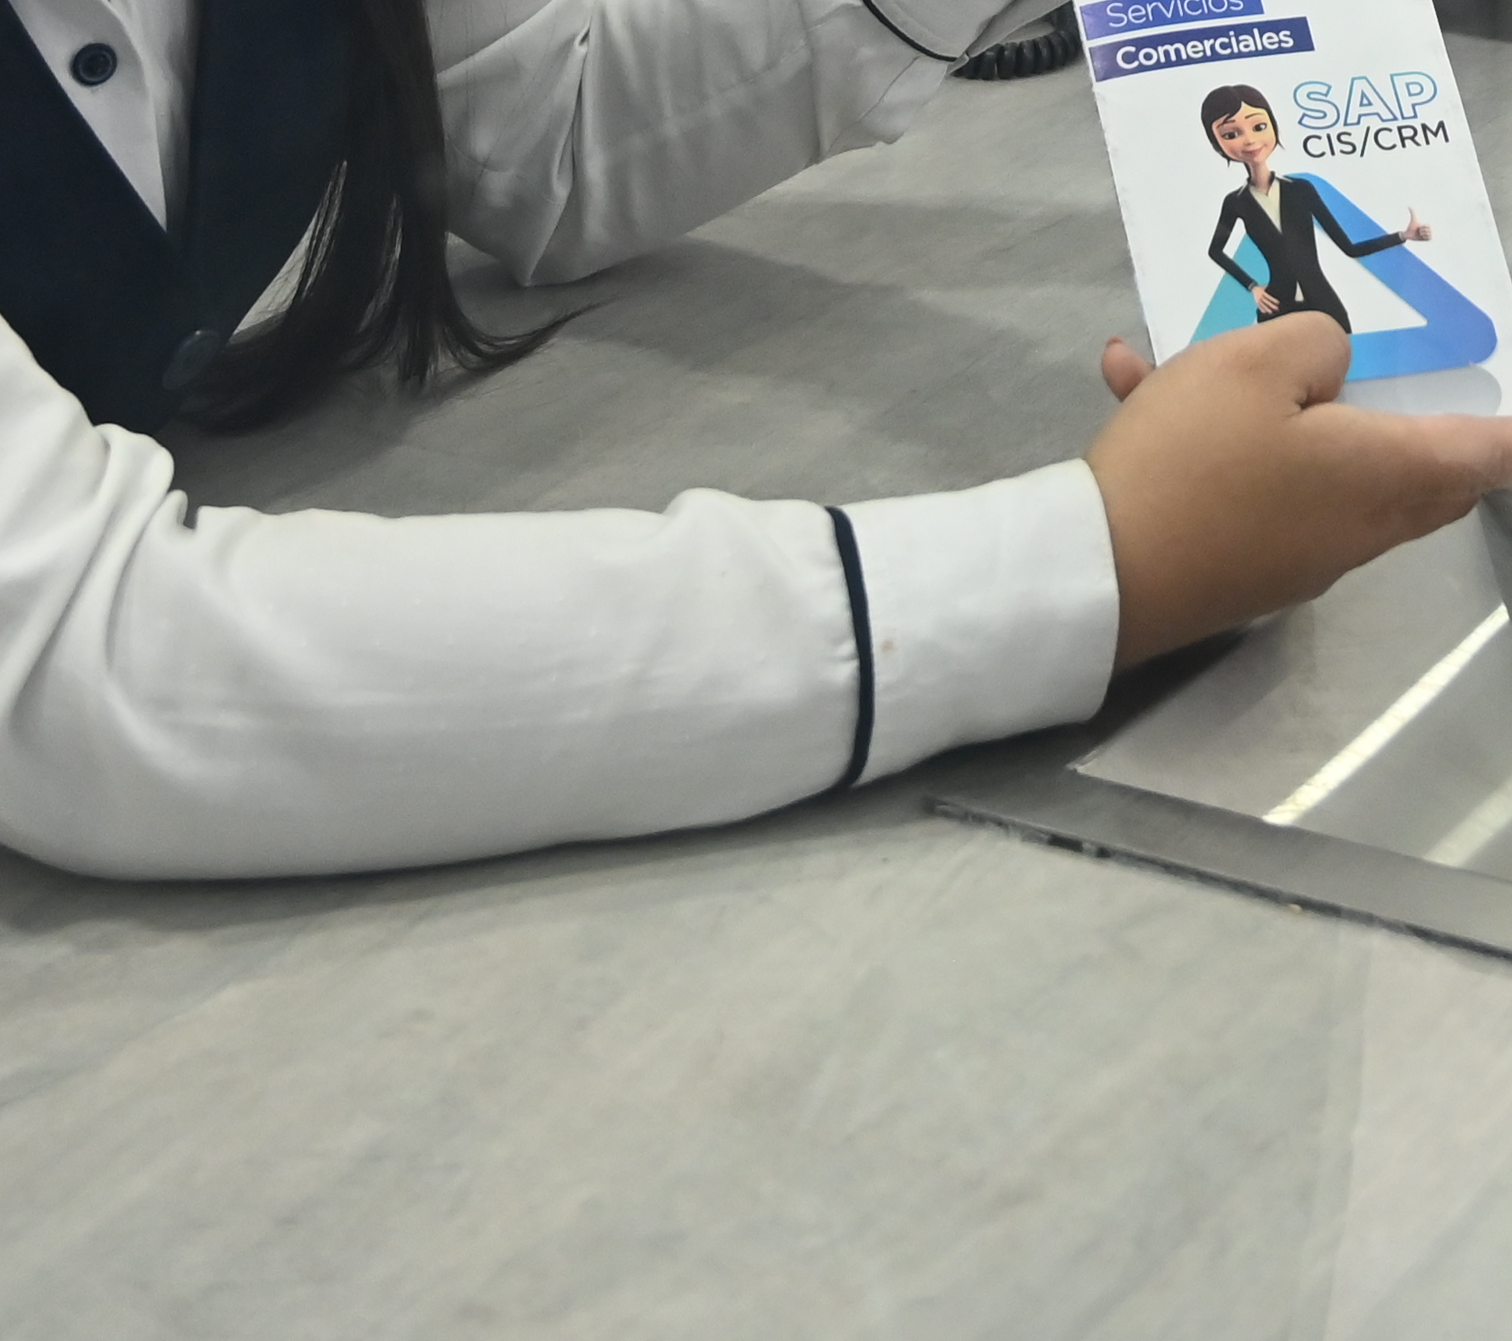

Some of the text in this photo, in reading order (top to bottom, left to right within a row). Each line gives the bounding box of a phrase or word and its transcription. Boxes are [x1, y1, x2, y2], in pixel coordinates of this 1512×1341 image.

[1115, 27, 1294, 69] Comerciales
[1292, 71, 1438, 130] SAP
[1302, 120, 1450, 158] CIS/CRM
